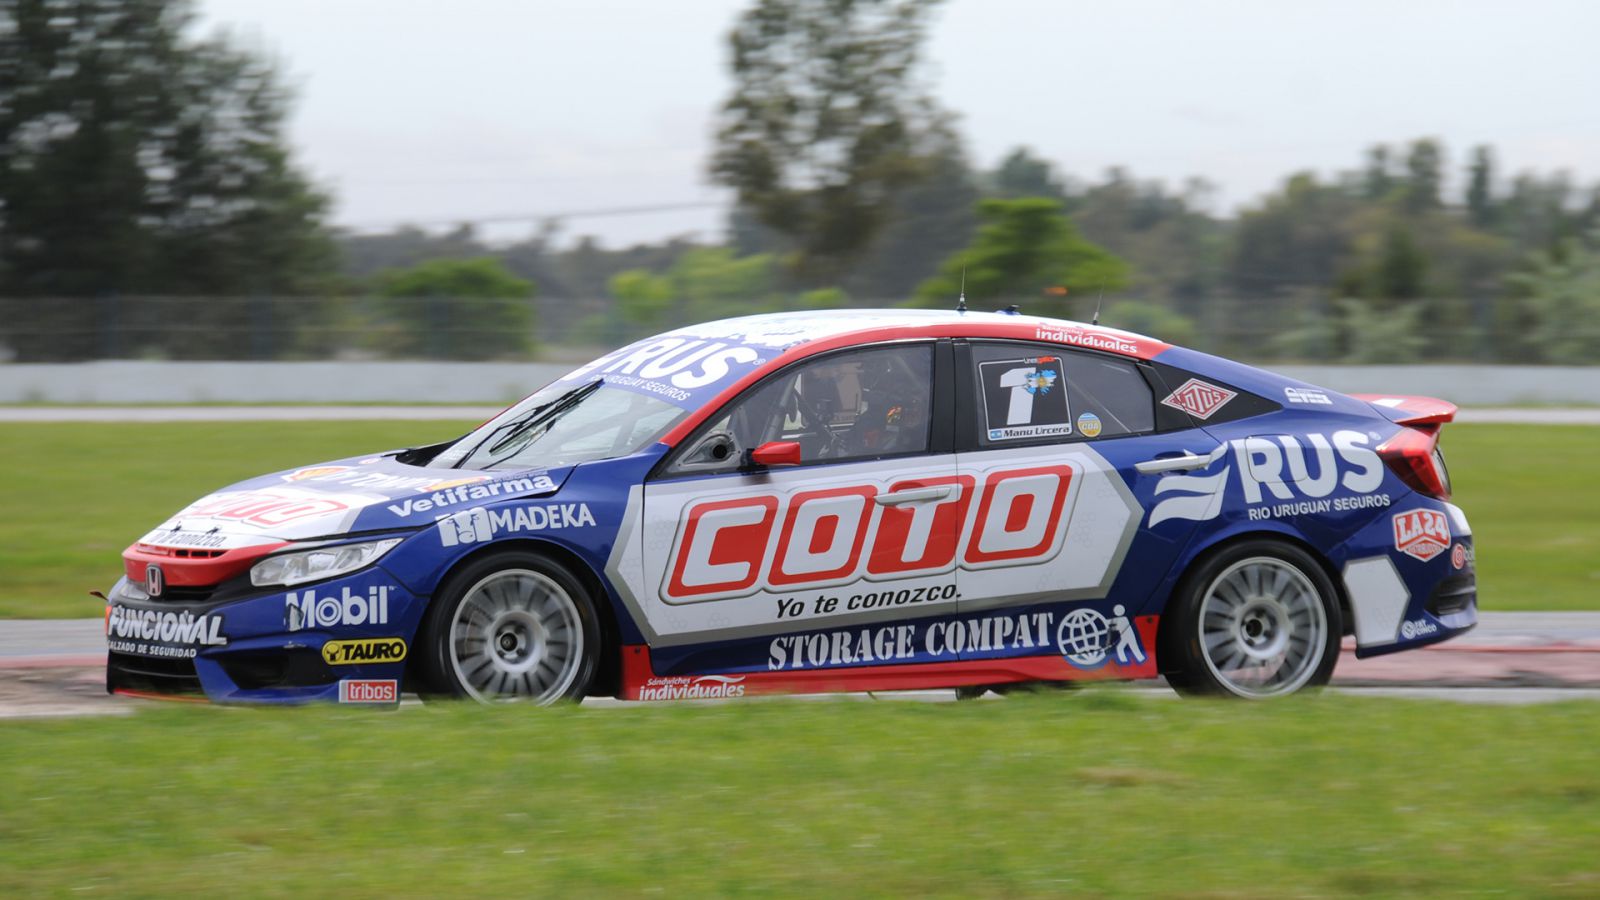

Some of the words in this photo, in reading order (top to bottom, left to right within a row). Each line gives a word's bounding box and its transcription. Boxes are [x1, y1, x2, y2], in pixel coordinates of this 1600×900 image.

[1035, 328, 1138, 353] individuales
[641, 380, 691, 402] SEGUROS
[999, 366, 1037, 425] 1
[1003, 429, 1033, 438] Manu
[1035, 425, 1070, 435] Urcera
[1231, 430, 1384, 504] RUS
[387, 475, 555, 518] Vetifarma
[1248, 505, 1271, 520] RIO
[1273, 500, 1332, 517] URUGUAY
[1334, 494, 1390, 512] SEGUROS
[489, 503, 597, 534] MADEKA
[667, 464, 1074, 598] COTO
[283, 586, 388, 632] Mobil
[776, 598, 804, 619] Yo
[814, 595, 838, 615] te
[847, 584, 963, 610] conozco.
[107, 605, 228, 645] FUNCIONAL
[137, 645, 147, 654] DE
[149, 646, 197, 658] SEGURIDAD
[342, 642, 404, 660] TAURO
[768, 624, 916, 671] STORAGE
[925, 612, 1054, 657] COMPAT
[350, 683, 393, 700] tribos
[640, 682, 745, 701] individuales
